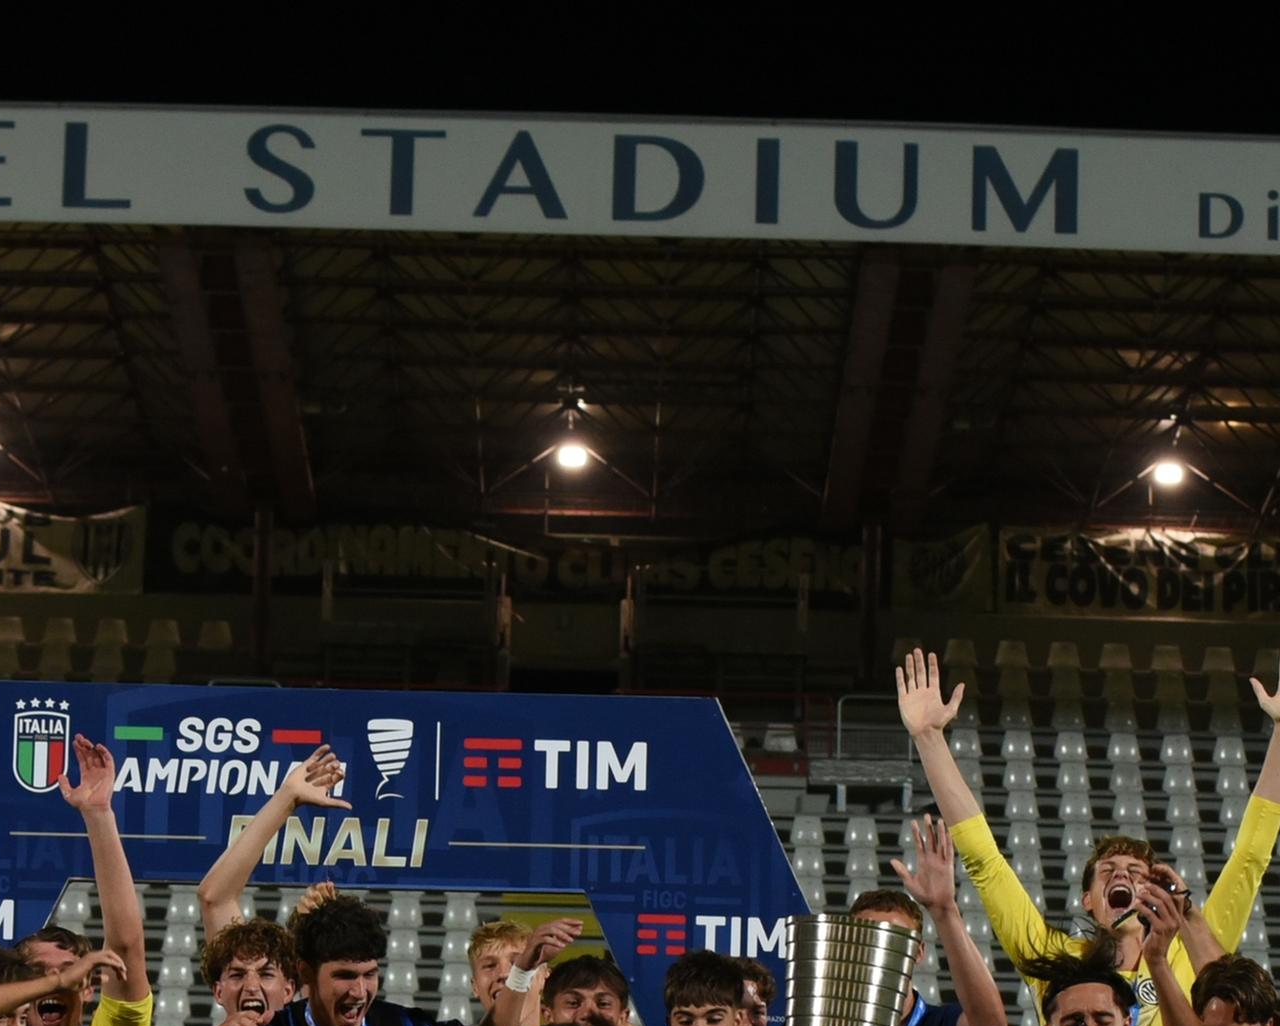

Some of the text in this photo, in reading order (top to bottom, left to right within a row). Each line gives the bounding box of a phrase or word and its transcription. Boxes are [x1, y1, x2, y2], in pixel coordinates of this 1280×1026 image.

[243, 123, 1079, 236] STADIUM
[18, 718, 65, 735] ITALIA
[176, 717, 262, 754] SGS
[112, 756, 347, 797] AMPIONI
[533, 739, 648, 791] TIM
[695, 915, 787, 959] TIM
